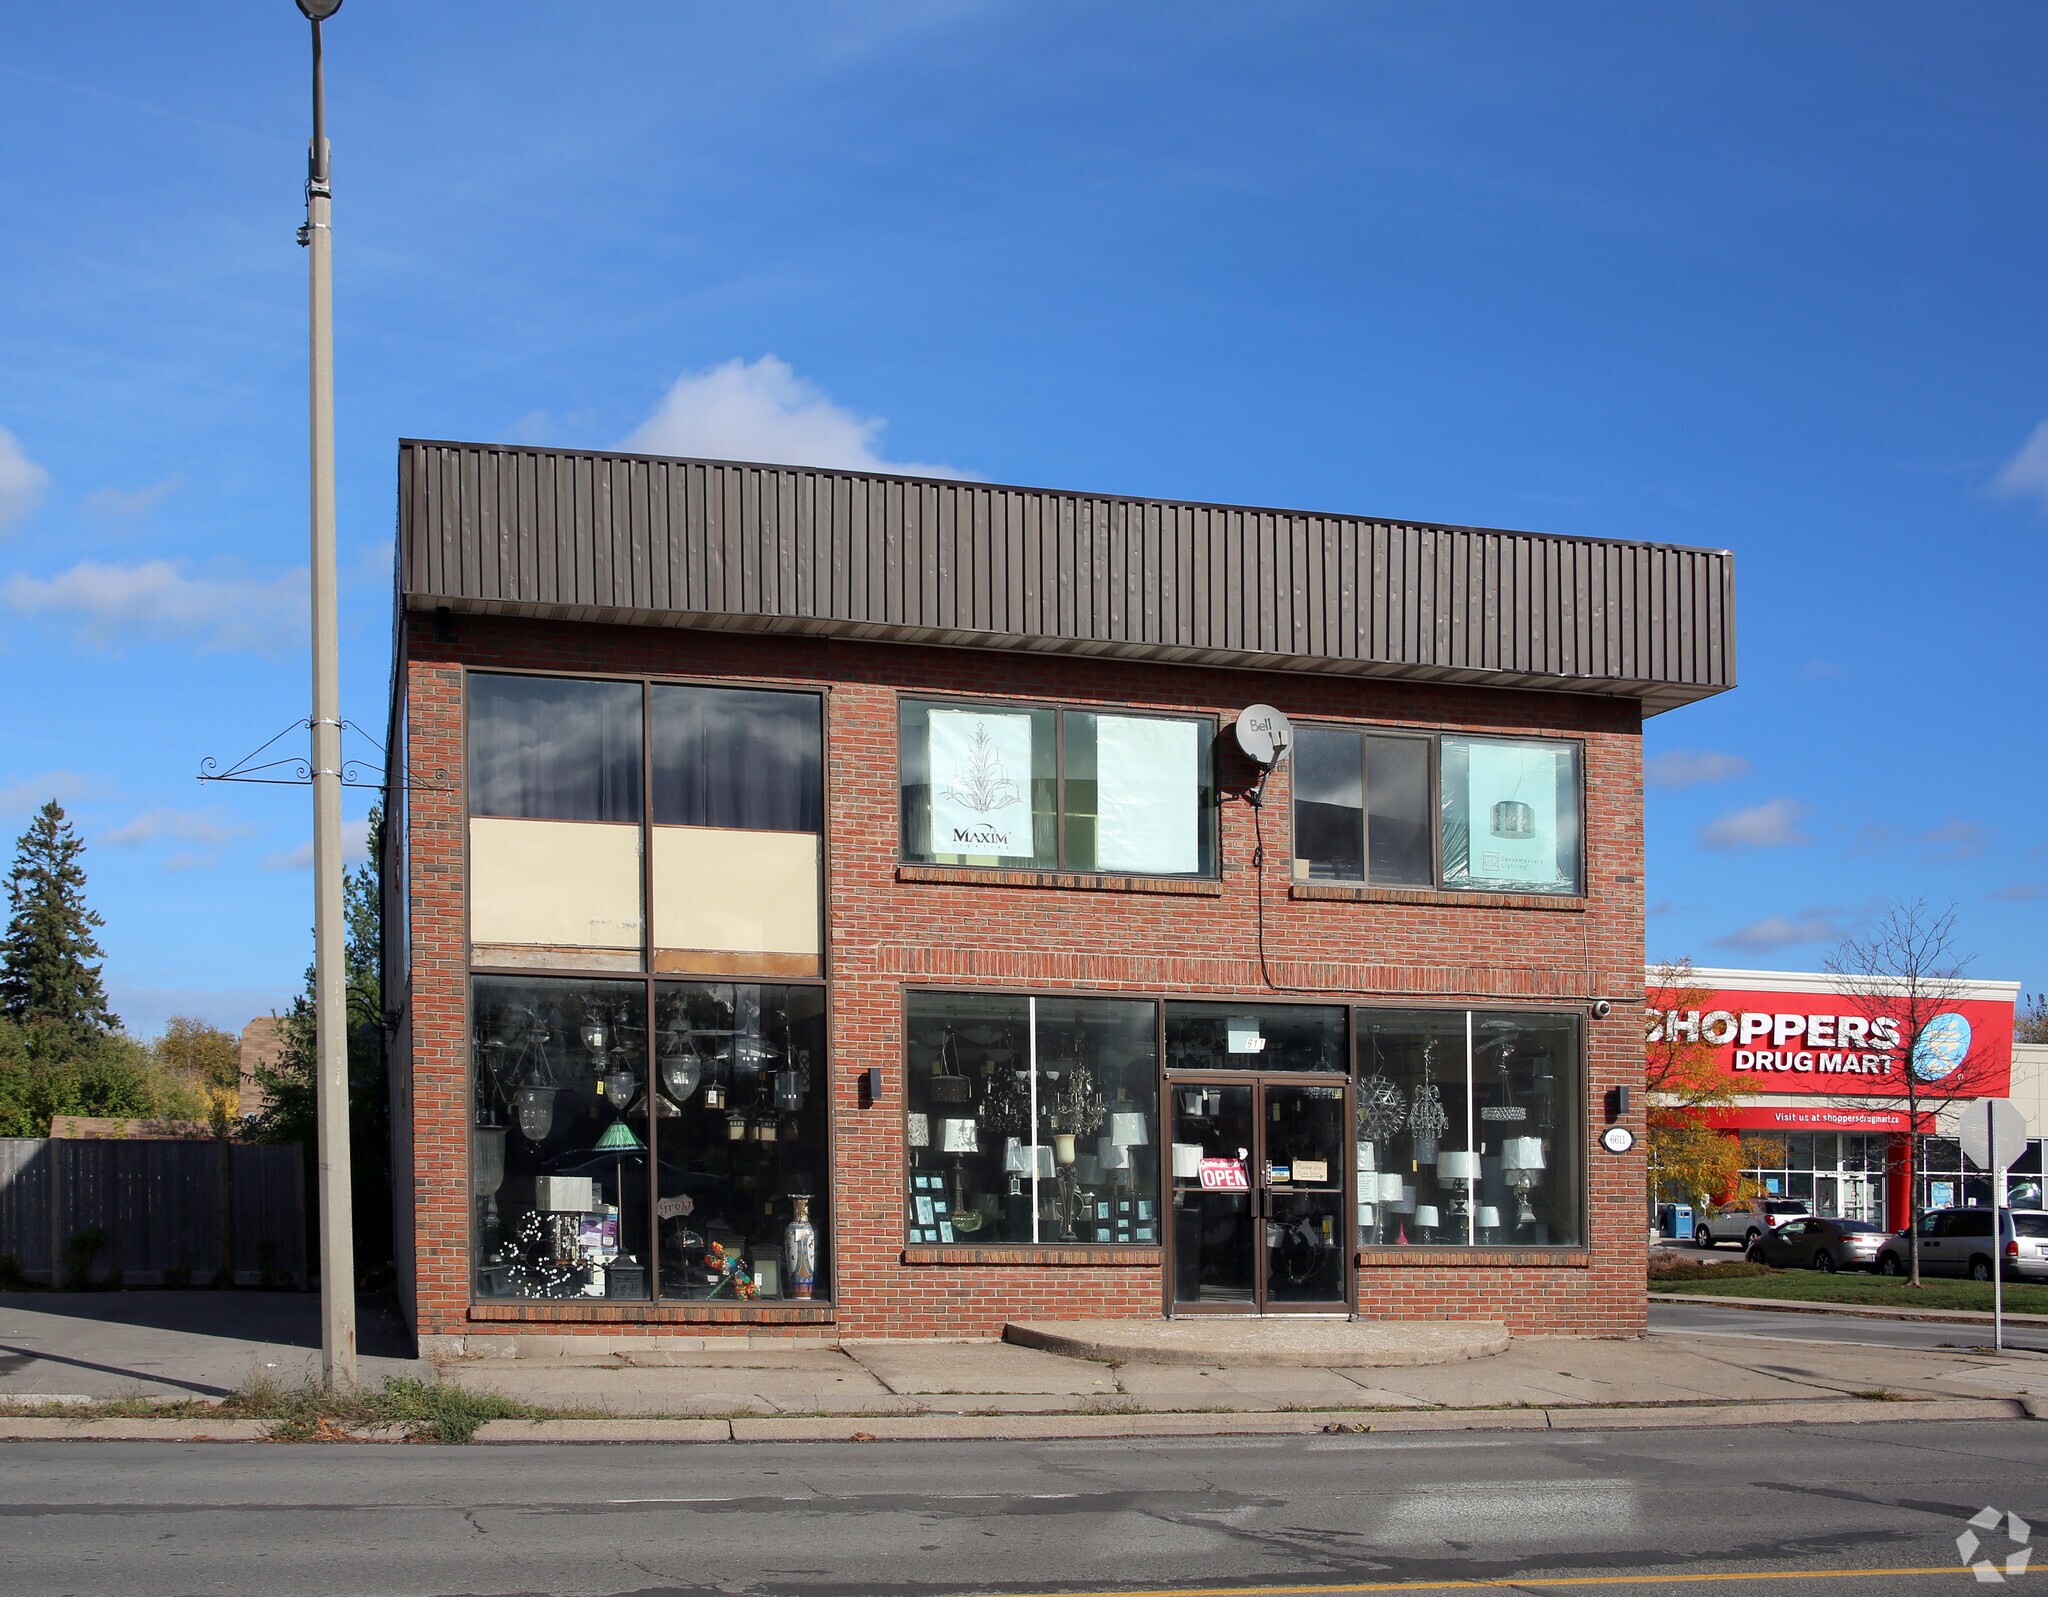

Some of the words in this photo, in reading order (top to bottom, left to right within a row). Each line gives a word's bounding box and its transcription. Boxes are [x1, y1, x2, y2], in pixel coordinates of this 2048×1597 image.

[1250, 718, 1272, 732] Bell
[952, 828, 1008, 844] MAXIM
[1735, 1051, 1813, 1072] DRUG
[1819, 1053, 1896, 1074] MART
[1775, 1112, 1796, 1122] Visit
[1811, 1114, 1820, 1122] at
[1822, 1114, 1899, 1125] shoppersdrugmart.ca
[1610, 1135, 1626, 1144] 6611
[1203, 1169, 1247, 1186] OPEN
